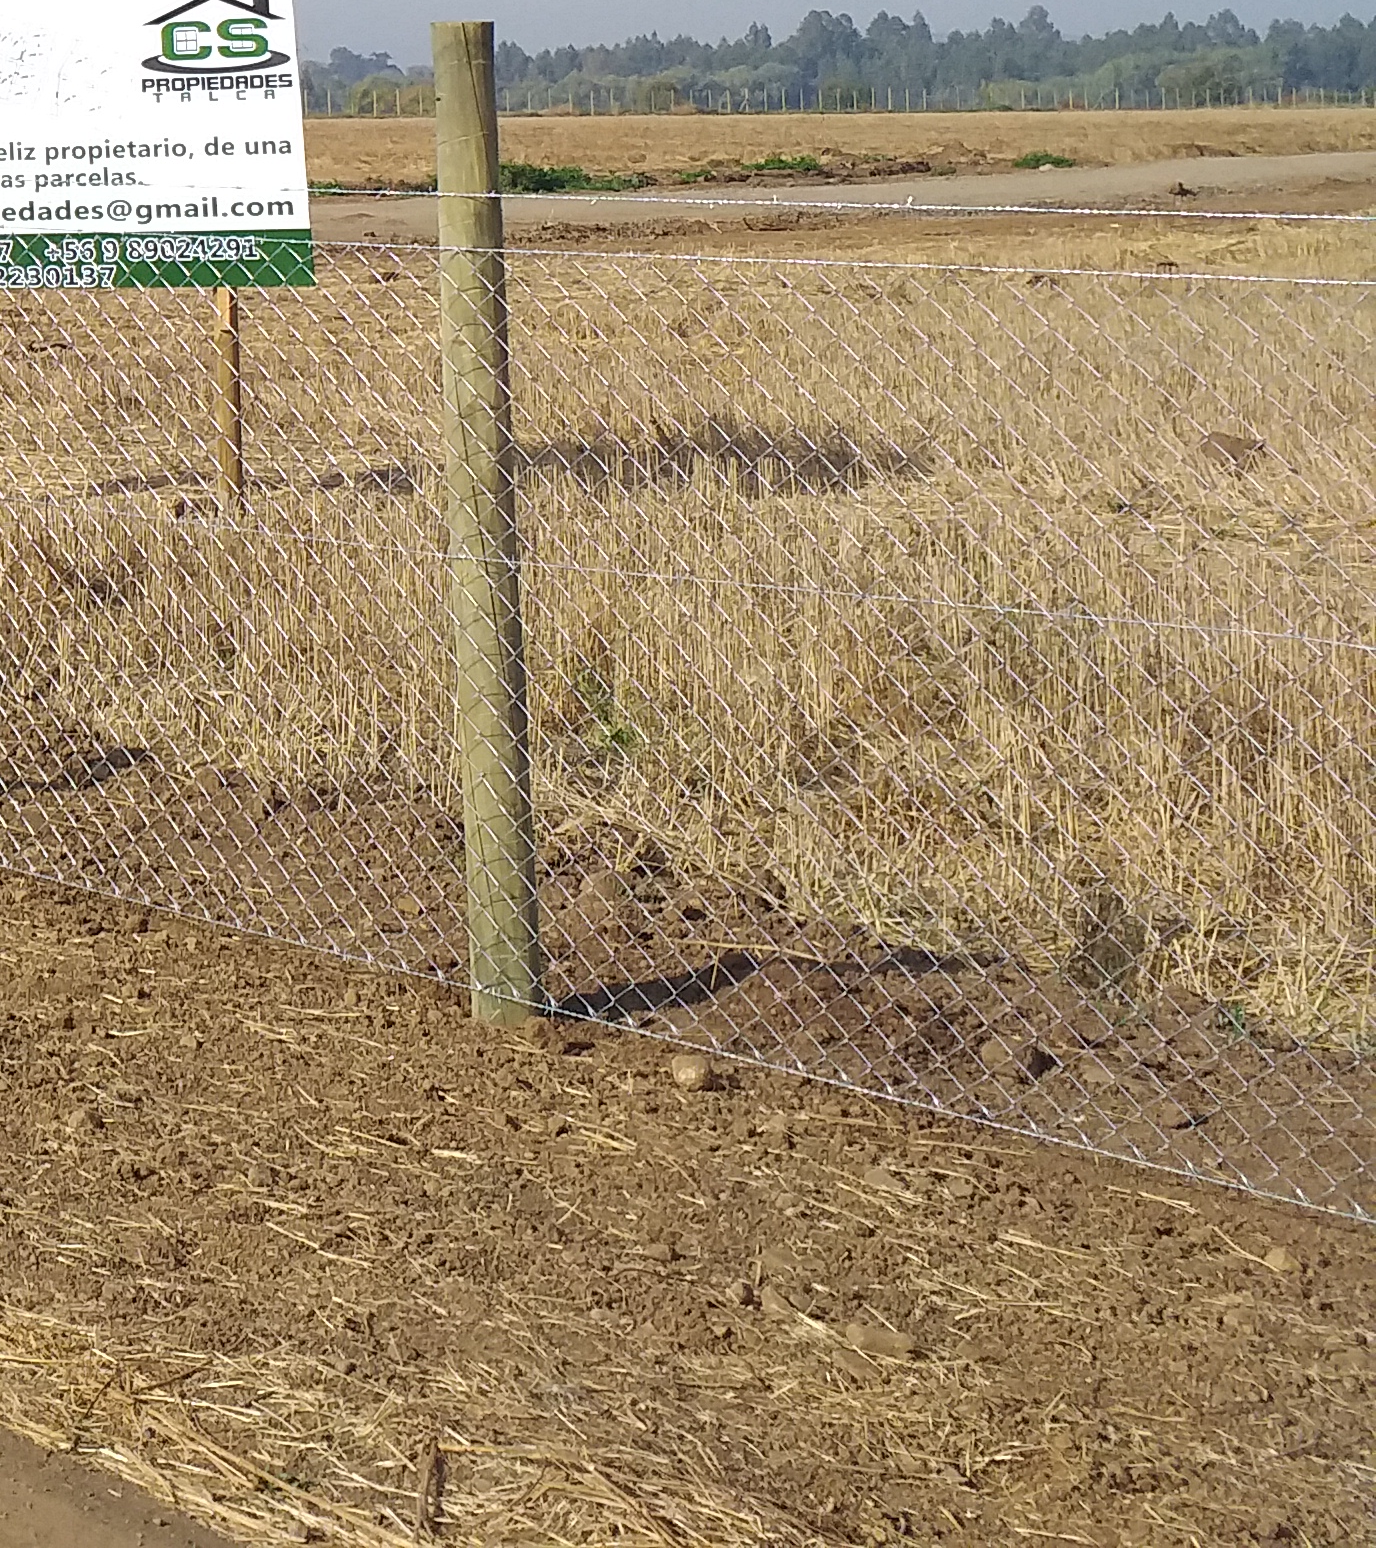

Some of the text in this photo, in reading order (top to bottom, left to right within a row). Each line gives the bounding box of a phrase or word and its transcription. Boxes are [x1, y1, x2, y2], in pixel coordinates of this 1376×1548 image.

[161, 18, 268, 61] CS
[141, 74, 293, 93] PROPIEDADES
[45, 137, 194, 165] propietario,
[204, 136, 235, 157] de
[245, 139, 292, 156] una
[34, 167, 144, 192] parcelas.
[101, 238, 119, 262] 9
[126, 236, 260, 261] 89024291
